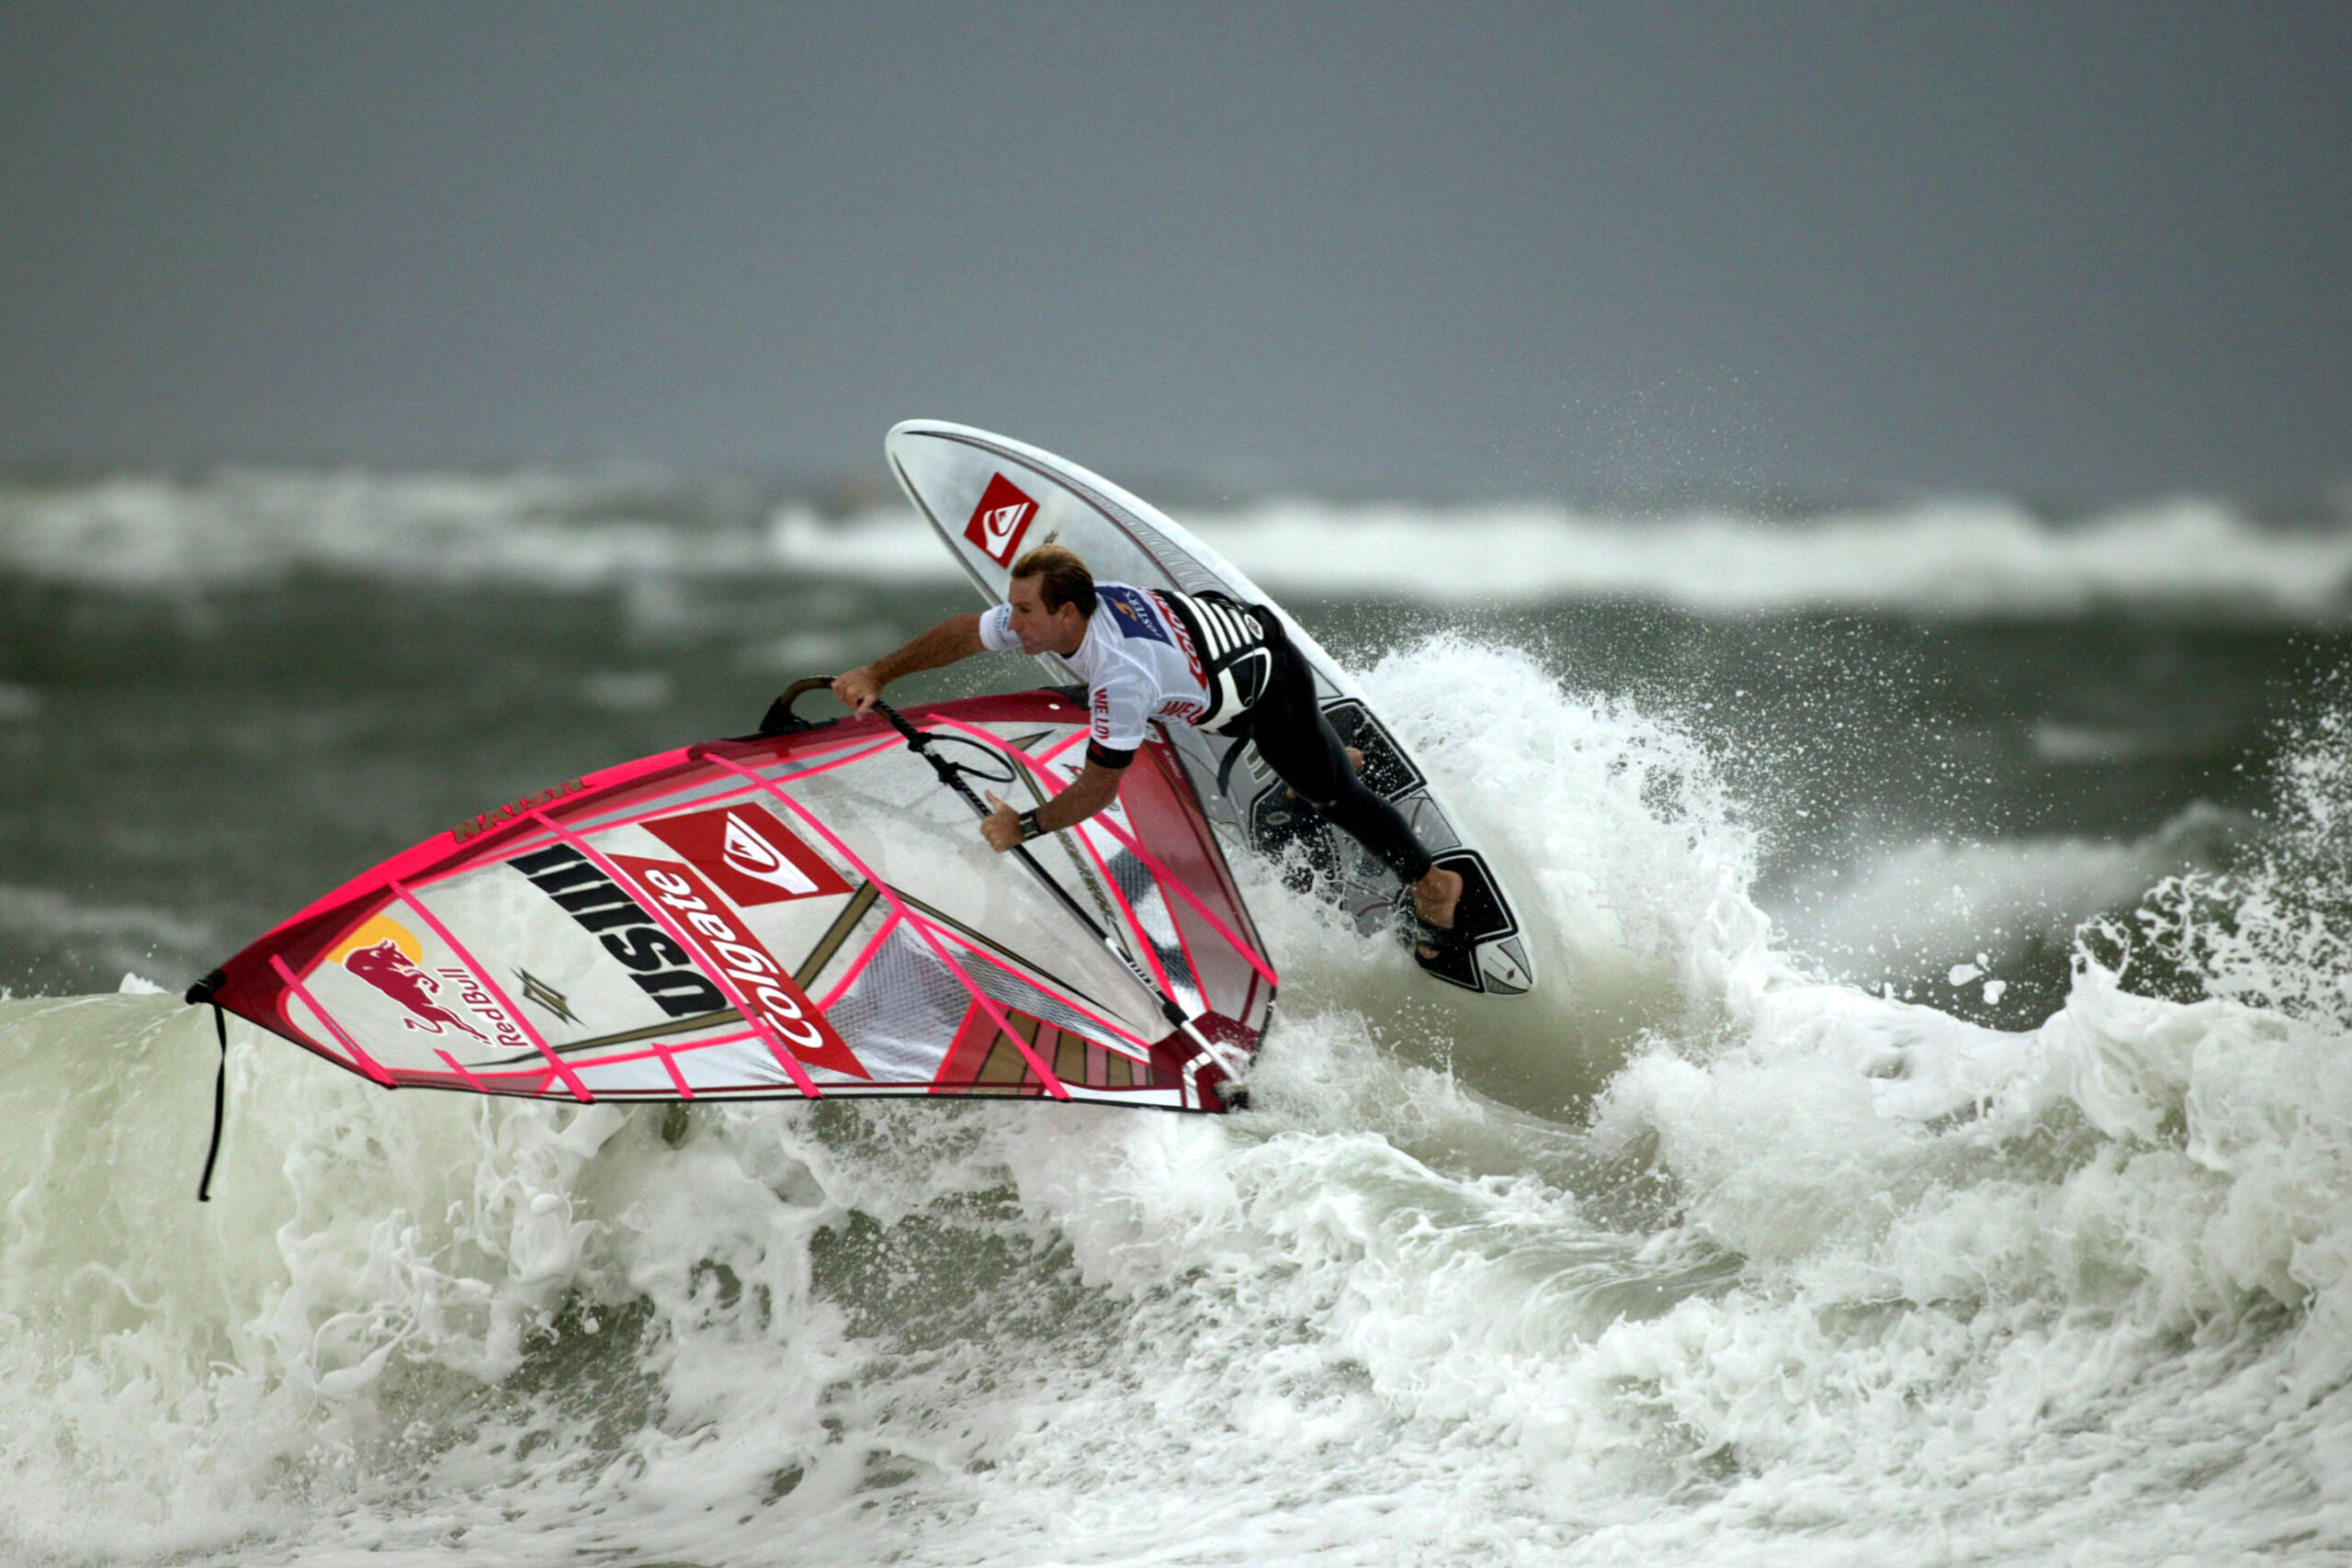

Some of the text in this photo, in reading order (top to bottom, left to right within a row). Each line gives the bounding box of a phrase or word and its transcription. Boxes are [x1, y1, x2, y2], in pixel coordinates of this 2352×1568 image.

[1094, 688, 1109, 715] WE
[1159, 701, 1195, 718] WE
[453, 777, 584, 843] NAISH
[645, 869, 823, 1048] Colgate
